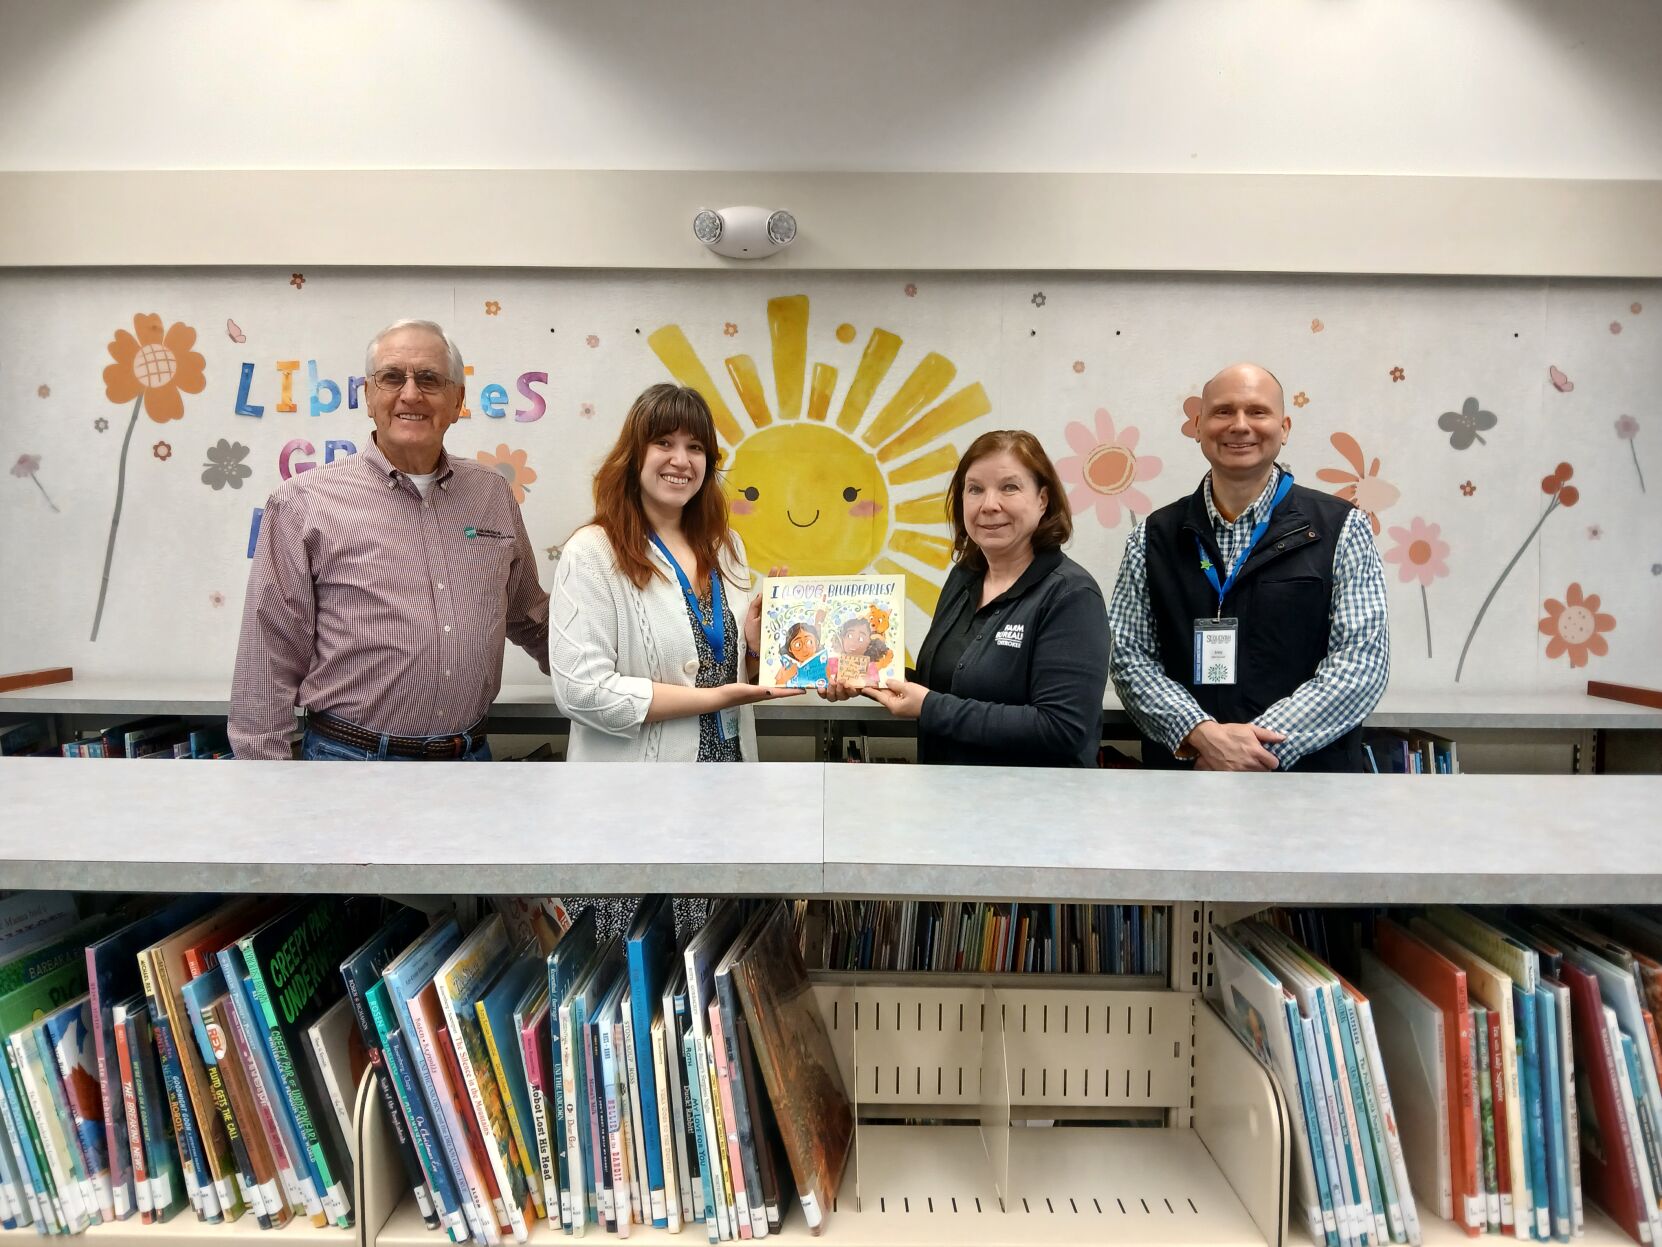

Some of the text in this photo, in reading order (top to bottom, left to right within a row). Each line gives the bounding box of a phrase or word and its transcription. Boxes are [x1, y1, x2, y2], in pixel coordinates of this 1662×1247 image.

[782, 584, 824, 600] LOVE
[827, 582, 896, 598] BLUEBERRIES!
[270, 921, 311, 988] CREEPY
[137, 958, 154, 993] MICHAEL REX
[346, 978, 358, 998] ROSEN
[547, 967, 557, 994] Rosenthal
[367, 999, 385, 1028] ROSEN
[159, 1025, 171, 1048] Michael
[206, 1027, 223, 1052] REX
[453, 1035, 465, 1051] The
[694, 1037, 704, 1053] Little
[1490, 1024, 1500, 1037] Tea
[266, 1035, 285, 1074] WHITEBLACK
[390, 1043, 407, 1072] Rosenberg
[413, 1017, 439, 1074] Rosen Reynolds
[622, 1020, 637, 1085] STONE SOUP ROSS
[685, 1047, 693, 1066] ROTH
[457, 1050, 474, 1078] Silence
[1479, 1053, 1488, 1069] the
[1492, 1052, 1503, 1070] Lady
[96, 1056, 113, 1126] Late for School
[152, 1025, 168, 1054] WANTS
[160, 1062, 176, 1092] NEEDS
[168, 1099, 185, 1132] ROBOTS
[268, 1028, 289, 1060] CREEPY
[279, 1057, 296, 1079] PAIR
[290, 1086, 320, 1142] UNDERWEAR!
[279, 1072, 289, 1085] the
[378, 1076, 391, 1093] Night
[387, 1099, 396, 1110] the
[466, 1077, 477, 1088] in
[469, 1086, 480, 1099] the
[553, 1062, 565, 1121] UNI THE UNICORN
[587, 1077, 596, 1100] Mama's
[699, 1073, 709, 1098] Sleepless
[1494, 1070, 1505, 1103] Sapphire
[135, 1077, 144, 1096] GOING
[142, 1125, 151, 1142] HUNT
[171, 1074, 193, 1131] GOODNIGHT GOON
[207, 1066, 239, 1141] PLUTO GETS THE CALL
[283, 1084, 299, 1115] PENGUIN
[589, 1100, 597, 1115] Milk
[683, 1084, 694, 1134] Duck! Rabbit!
[702, 1097, 711, 1114] Night
[1356, 1056, 1385, 1144] The Problem with Pumpkins
[123, 1081, 143, 1171] THE BREAKING NEWS
[473, 1098, 492, 1137] Mountains
[660, 1105, 669, 1124] GOES
[662, 1123, 670, 1133] TO
[1376, 1082, 1405, 1165] HOT DOG
[299, 1131, 309, 1144] the
[413, 1114, 443, 1173] On Christmas Eve
[530, 1084, 553, 1181] Robot Lost His Head
[566, 1118, 576, 1149] Dear Girl
[662, 1133, 671, 1146] THE
[691, 1097, 707, 1166] MY LOVE FOR YOU
[303, 1142, 316, 1164] WORLD
[611, 1151, 622, 1182] BANDIT
[664, 1146, 674, 1174] DENTIST
